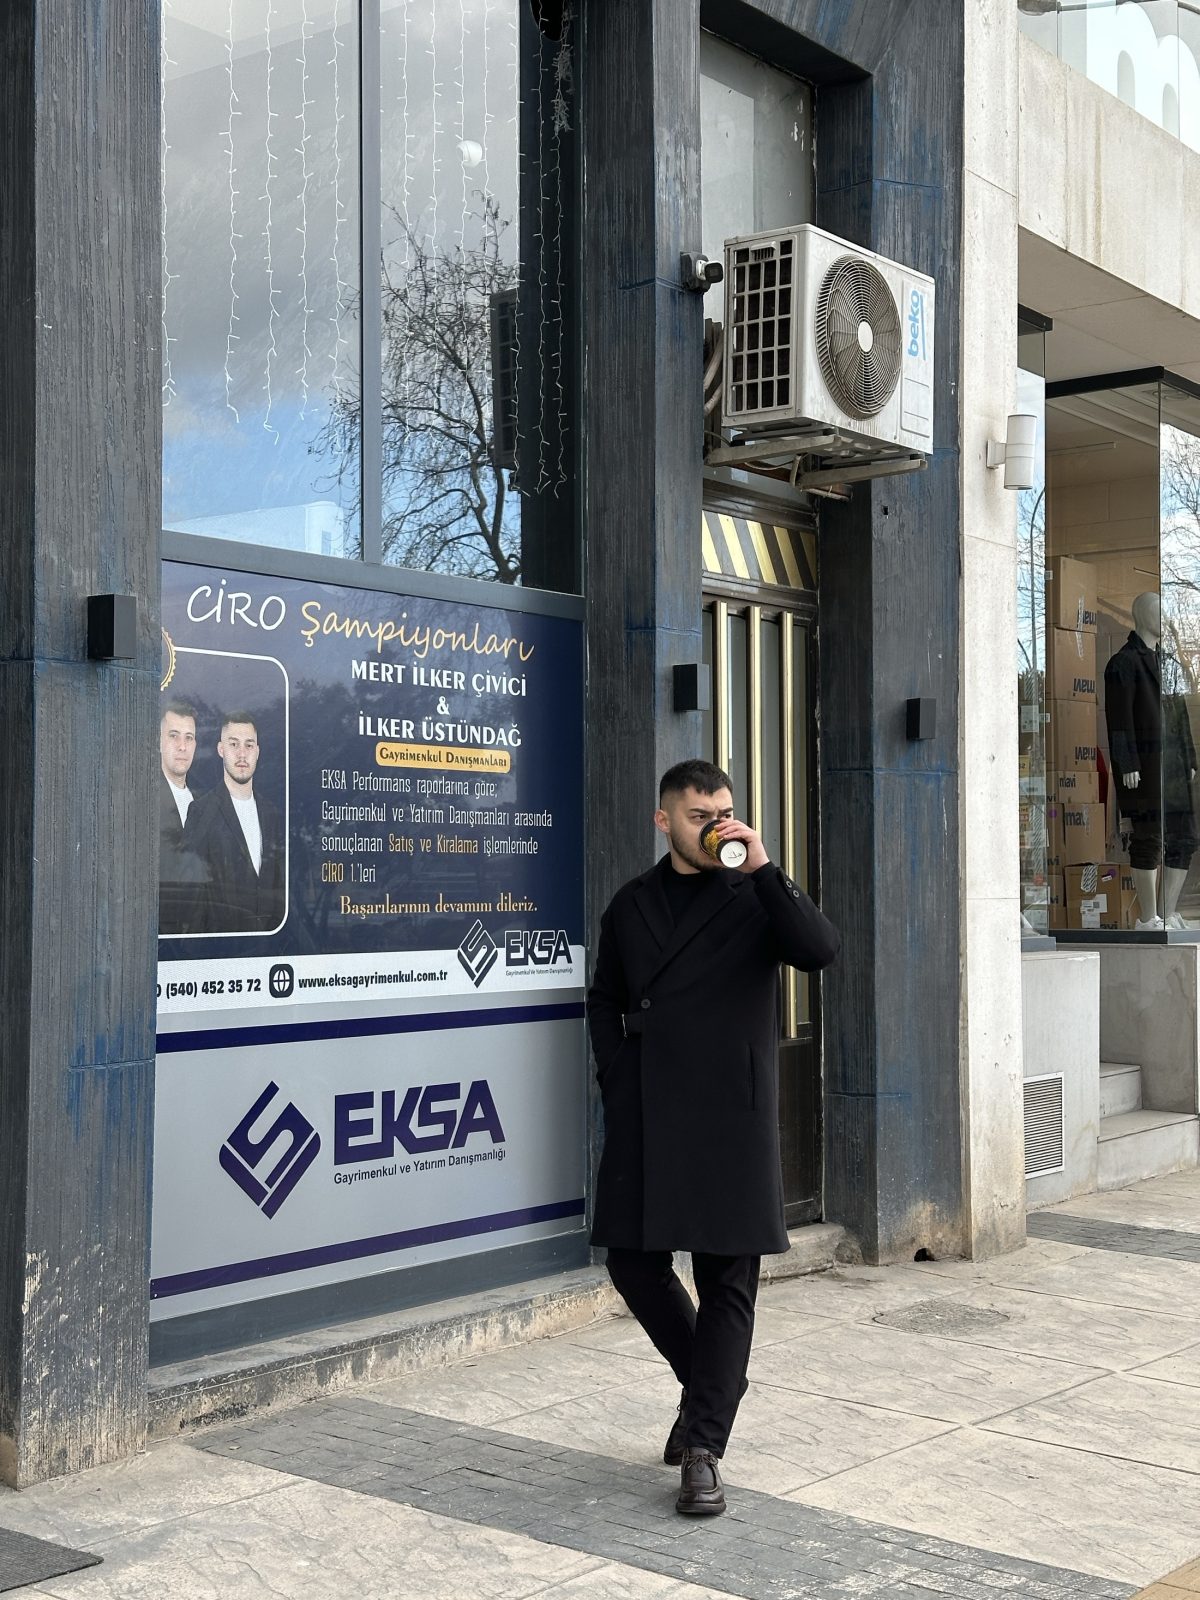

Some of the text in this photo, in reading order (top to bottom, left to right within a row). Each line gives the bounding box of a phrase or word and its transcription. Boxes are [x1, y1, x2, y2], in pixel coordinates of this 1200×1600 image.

[908, 290, 919, 356] beko
[187, 579, 534, 661] CİRO Şampiyonları
[351, 659, 527, 697] MERT İLKER ÇİVİCİ
[437, 696, 450, 715] &
[358, 711, 522, 747] İLKER ÜSTÜNDAĞ
[321, 769, 498, 799] EKSA Performans raporlarına göre;
[321, 800, 553, 828] Gayrimenkul ve Yatırım Danışmanları arasında
[321, 832, 539, 857] sonuçlanan Satış ve Kiralama işlemlerinde
[321, 860, 344, 883] CİRO
[340, 892, 538, 919] Başarılarının devamını dileriz.
[505, 930, 573, 966] EKSA
[166, 981, 198, 999] (540)
[201, 980, 225, 995] 452
[228, 980, 243, 993] 35
[246, 978, 262, 992] 72
[298, 969, 448, 988] www.eksagayrimenkul.com.tr
[334, 1079, 506, 1165] EKSA
[334, 1148, 506, 1185] Gayrimenkul ve Yatırım Danışmanlığı
